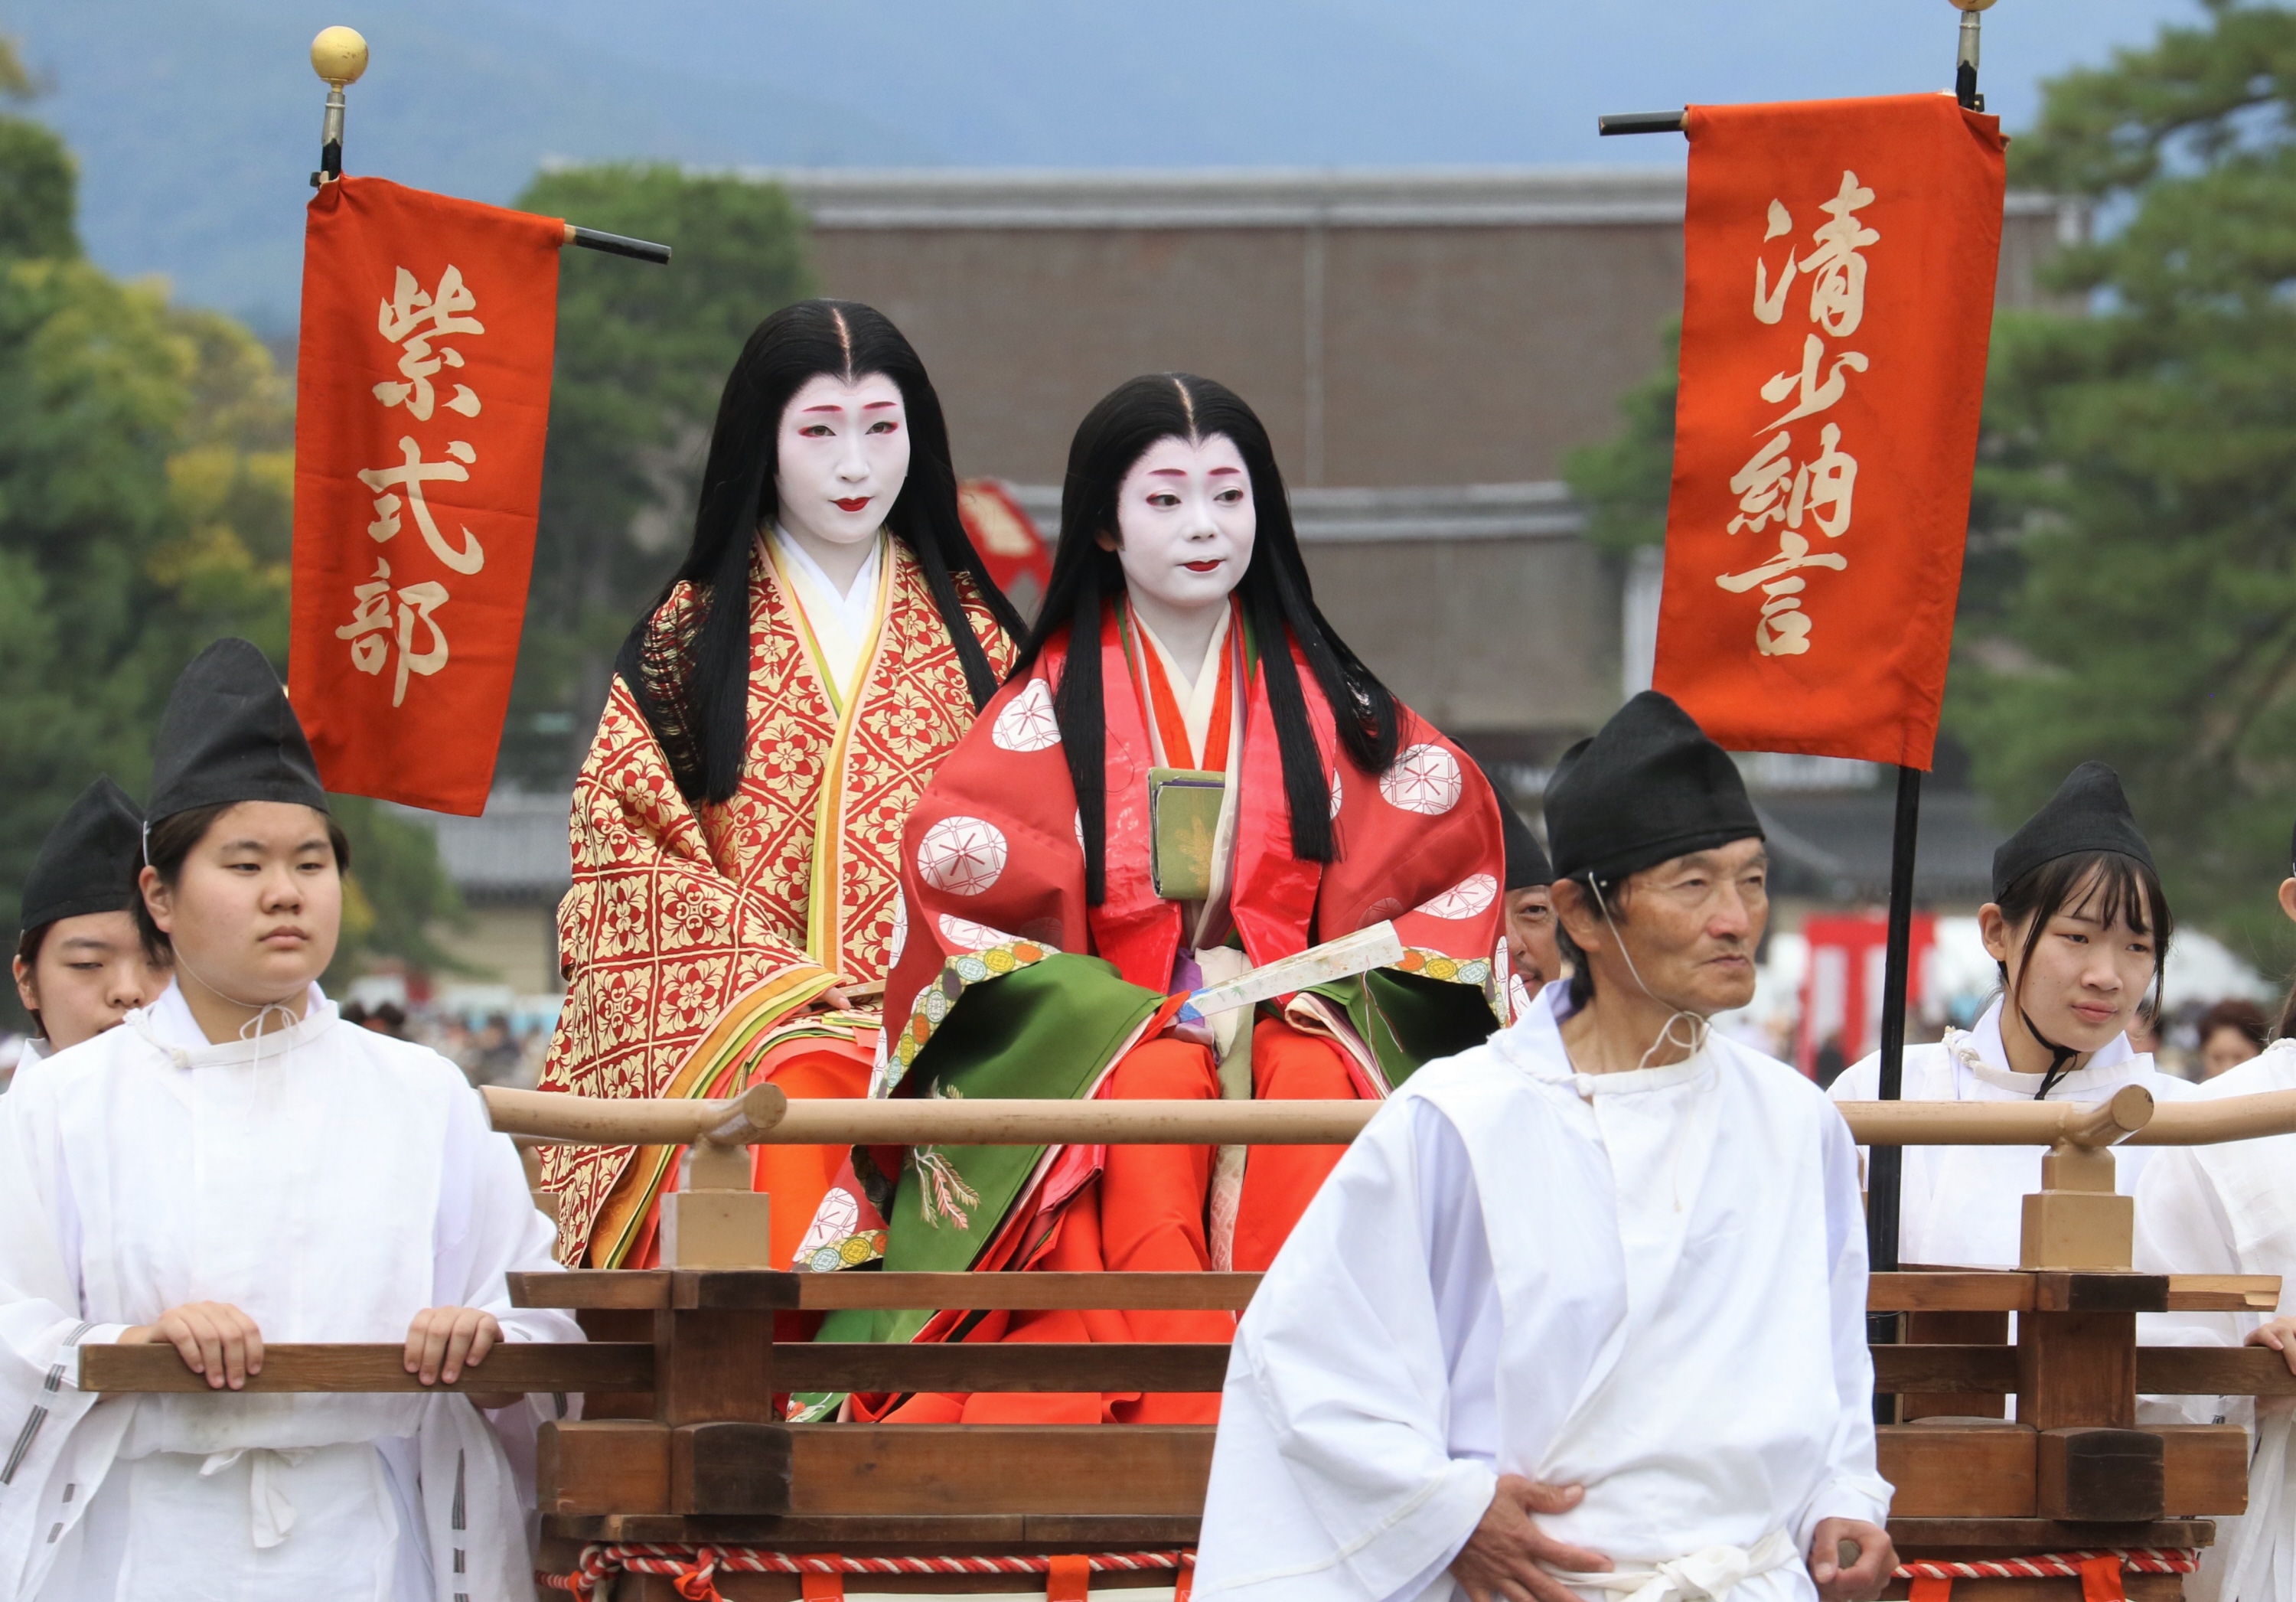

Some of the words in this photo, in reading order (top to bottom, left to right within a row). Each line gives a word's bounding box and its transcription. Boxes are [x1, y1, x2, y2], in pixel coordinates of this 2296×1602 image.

[335, 264, 485, 708] 紫式部
[1716, 170, 1880, 657] 清少納言
